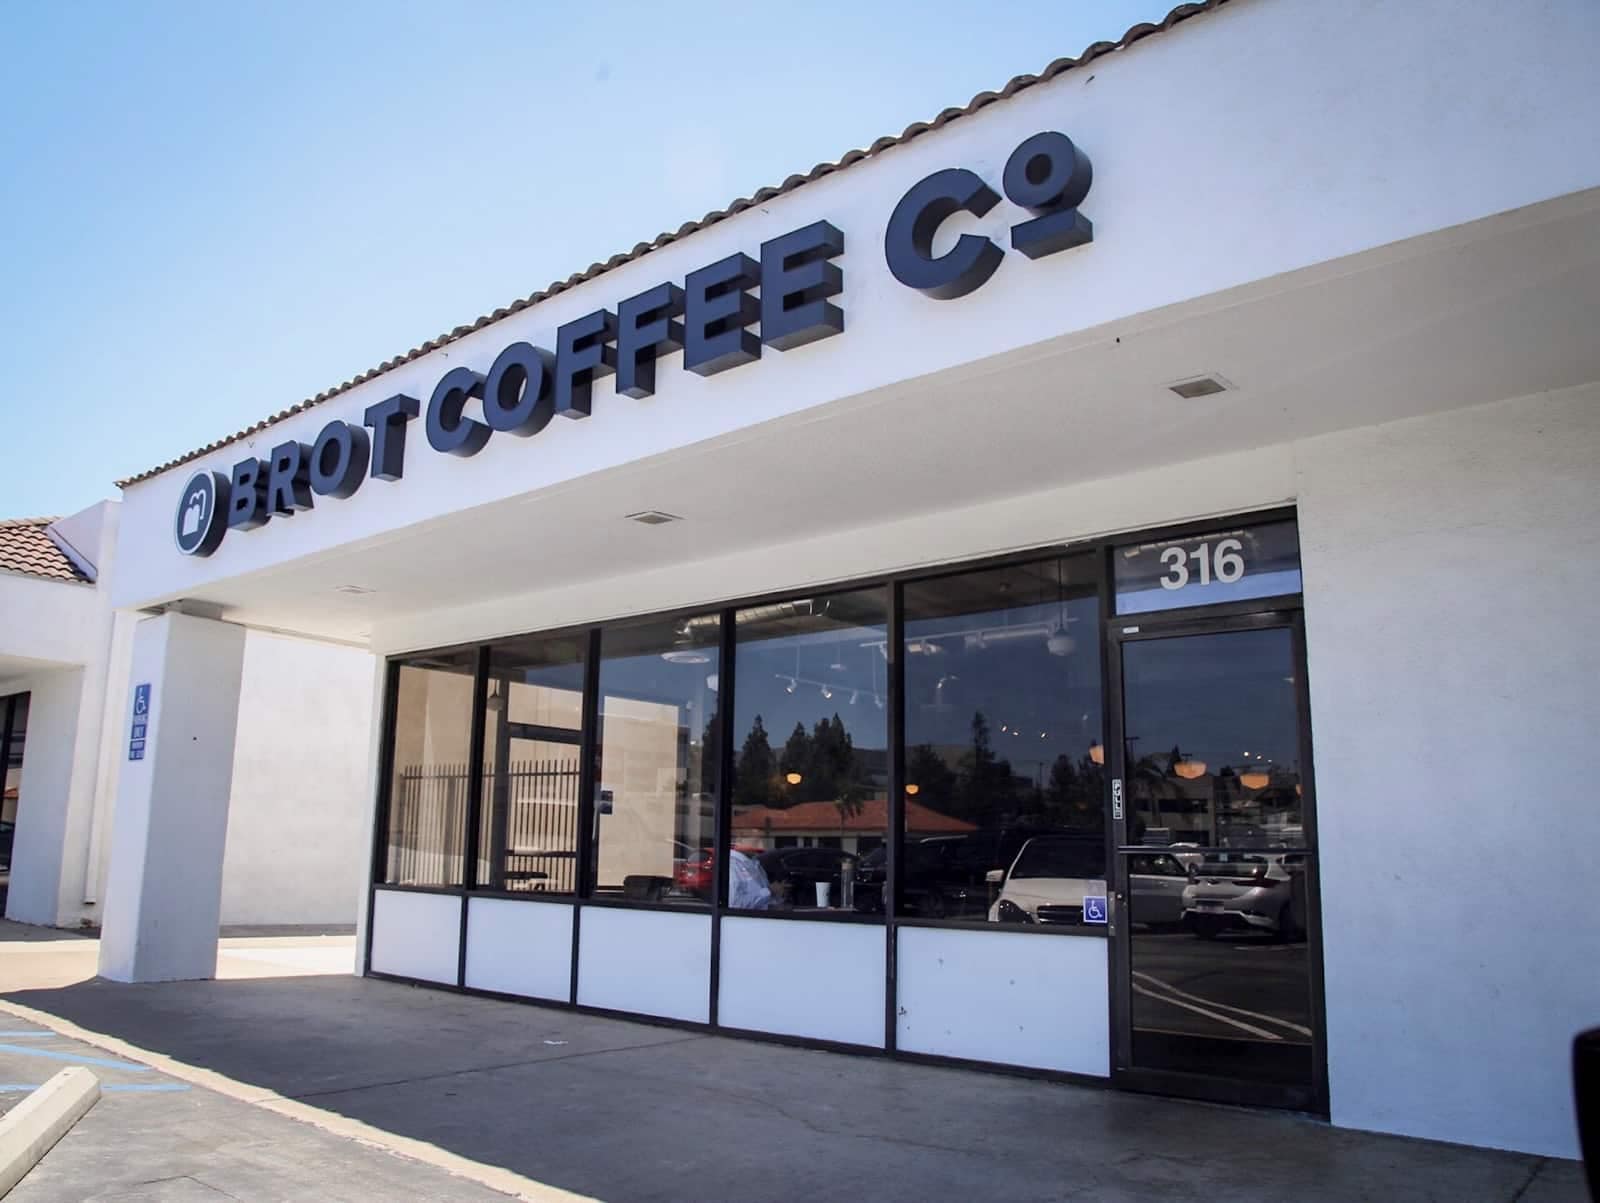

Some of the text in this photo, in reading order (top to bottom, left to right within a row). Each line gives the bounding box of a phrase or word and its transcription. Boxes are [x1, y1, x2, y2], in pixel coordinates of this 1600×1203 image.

[227, 394, 419, 531] BROT
[425, 219, 844, 457] COFFEE
[1159, 538, 1245, 591] 316
